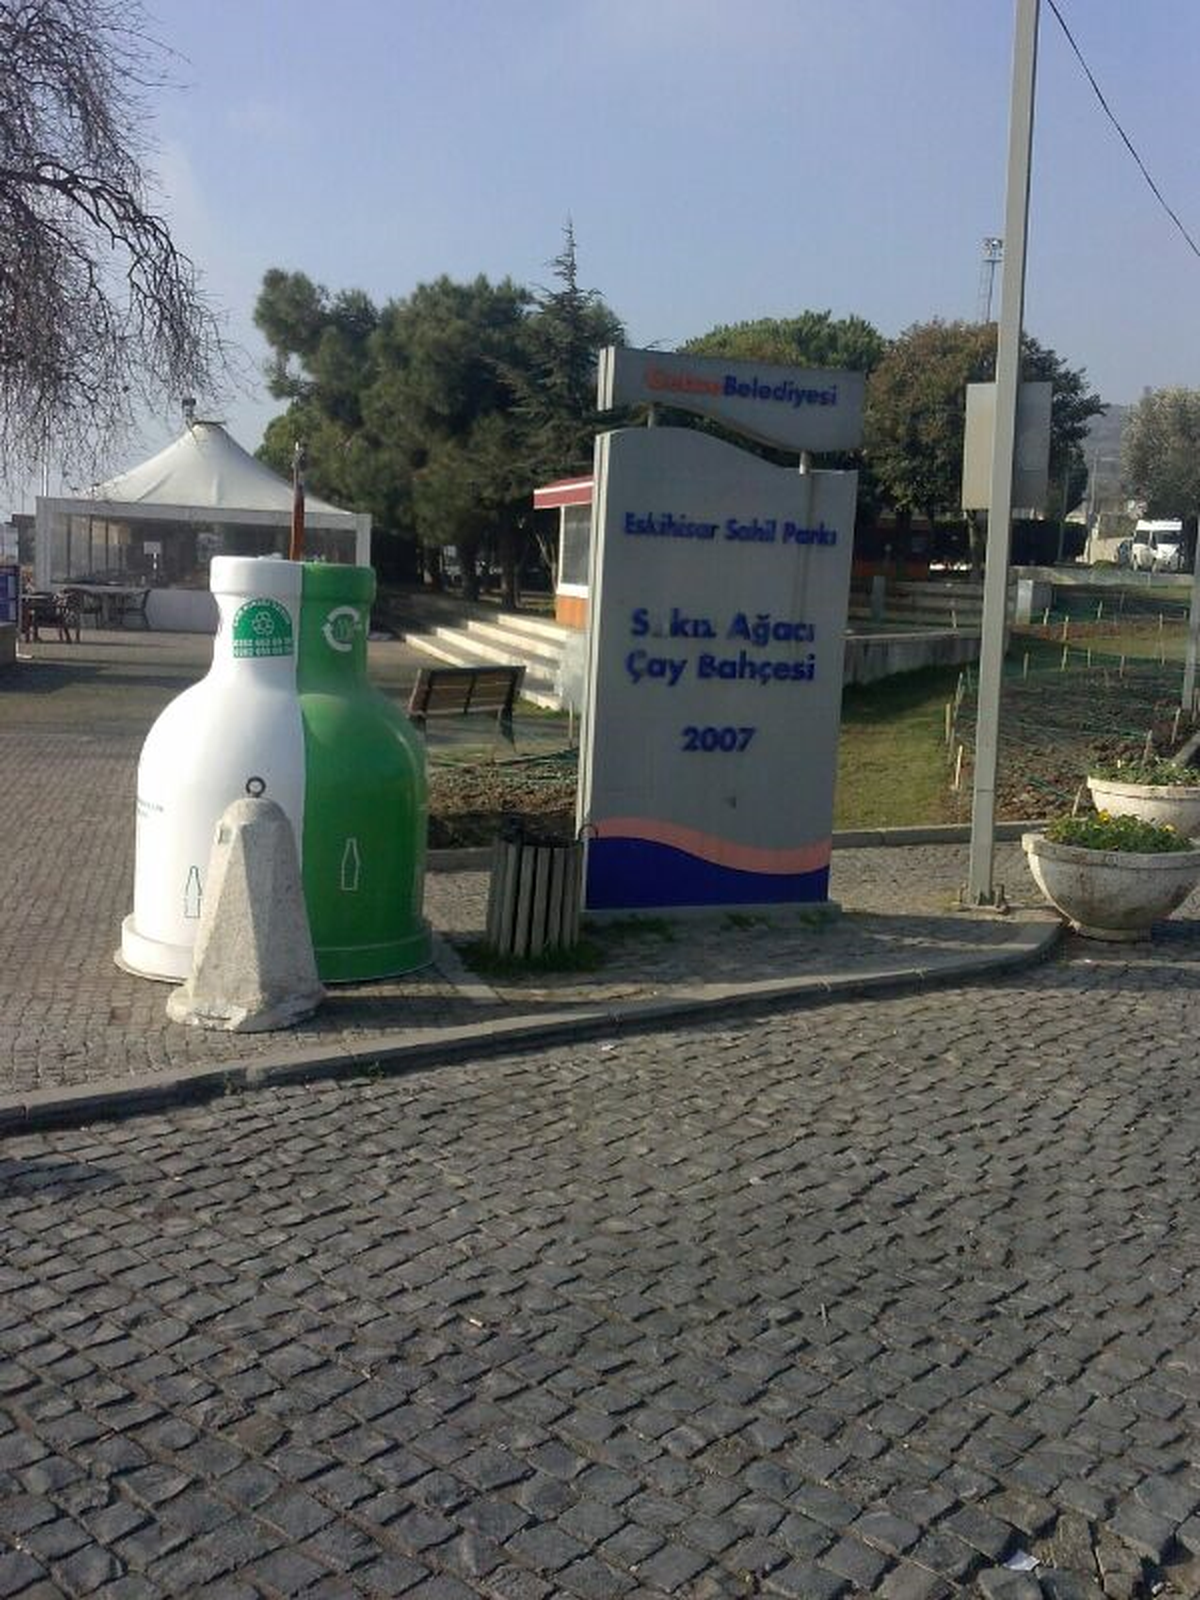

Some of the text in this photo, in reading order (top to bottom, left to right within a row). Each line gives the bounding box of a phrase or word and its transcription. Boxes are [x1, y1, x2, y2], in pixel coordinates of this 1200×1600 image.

[725, 519, 777, 543] Sahil
[728, 612, 815, 647] Ağacı
[625, 651, 816, 687] Çay Bahçesi
[682, 726, 756, 752] 2007
